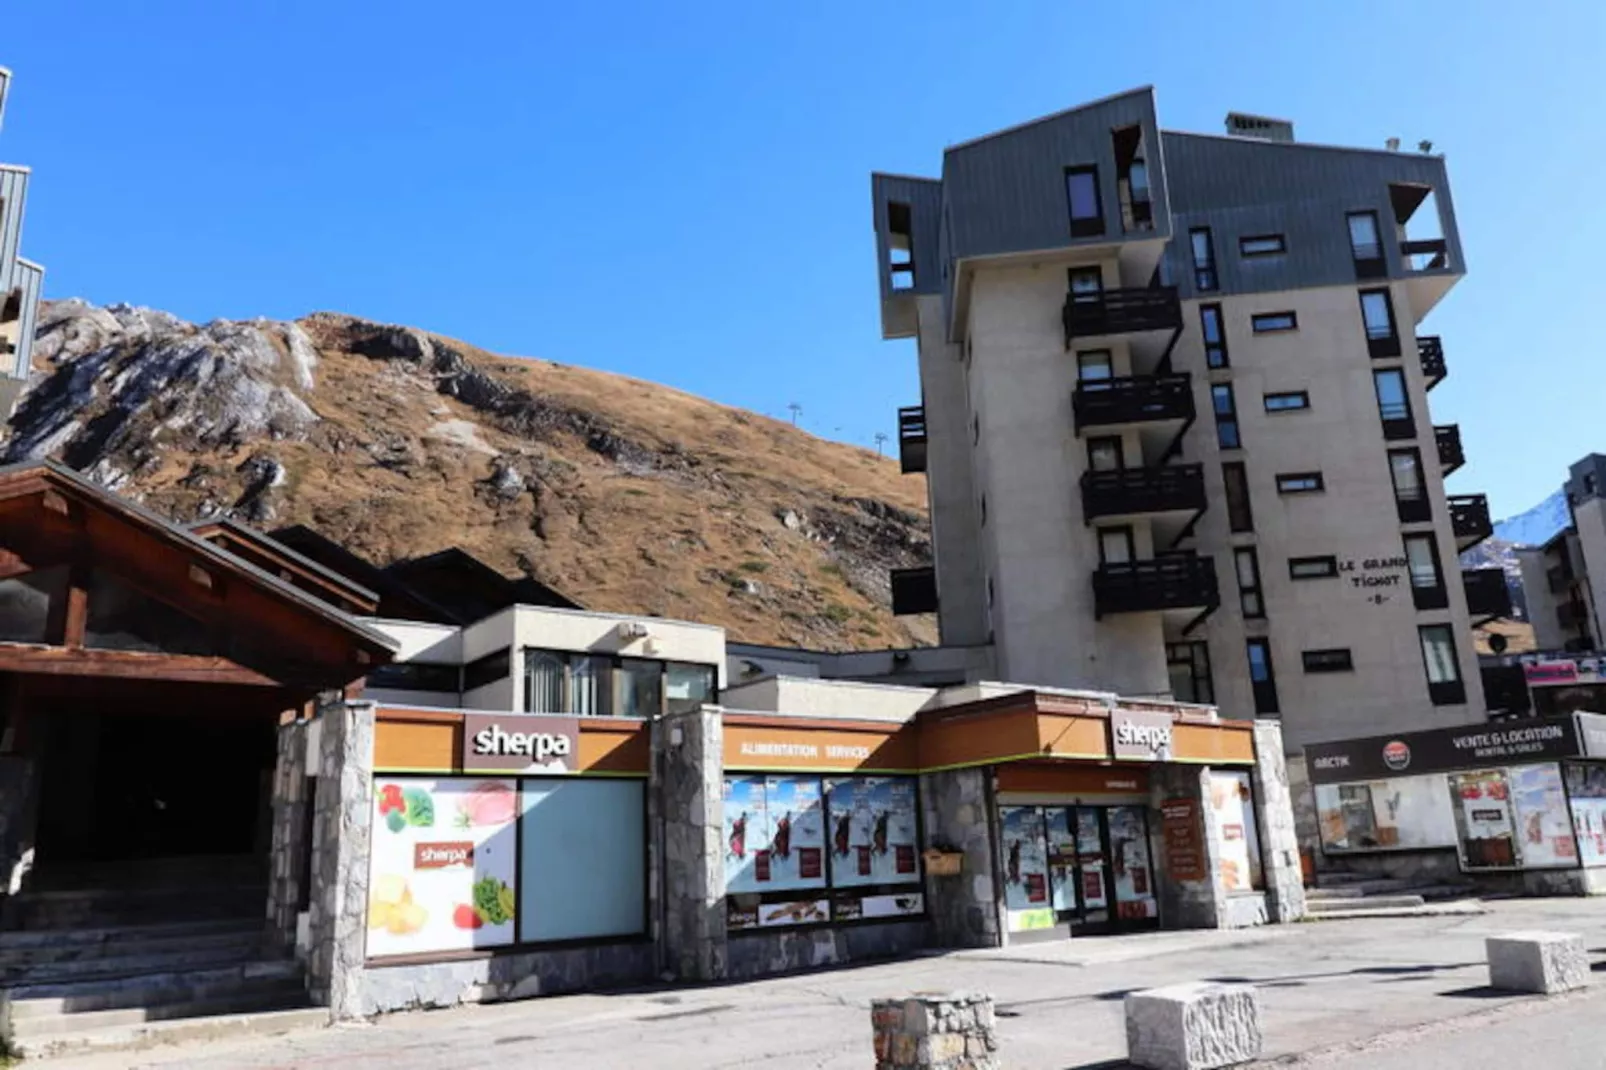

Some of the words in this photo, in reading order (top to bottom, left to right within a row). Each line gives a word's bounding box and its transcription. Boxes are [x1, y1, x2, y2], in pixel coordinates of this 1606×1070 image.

[1339, 560, 1355, 572] LE
[1362, 557, 1408, 570] GRAND
[475, 724, 571, 761] sherpa
[1116, 719, 1172, 752] sherpa
[1453, 733, 1491, 749] VENTE
[1501, 725, 1563, 744] LOCATION
[740, 741, 818, 758] ALIMENTATION
[824, 745, 870, 759] SERVICES
[420, 846, 467, 864] sherpa
